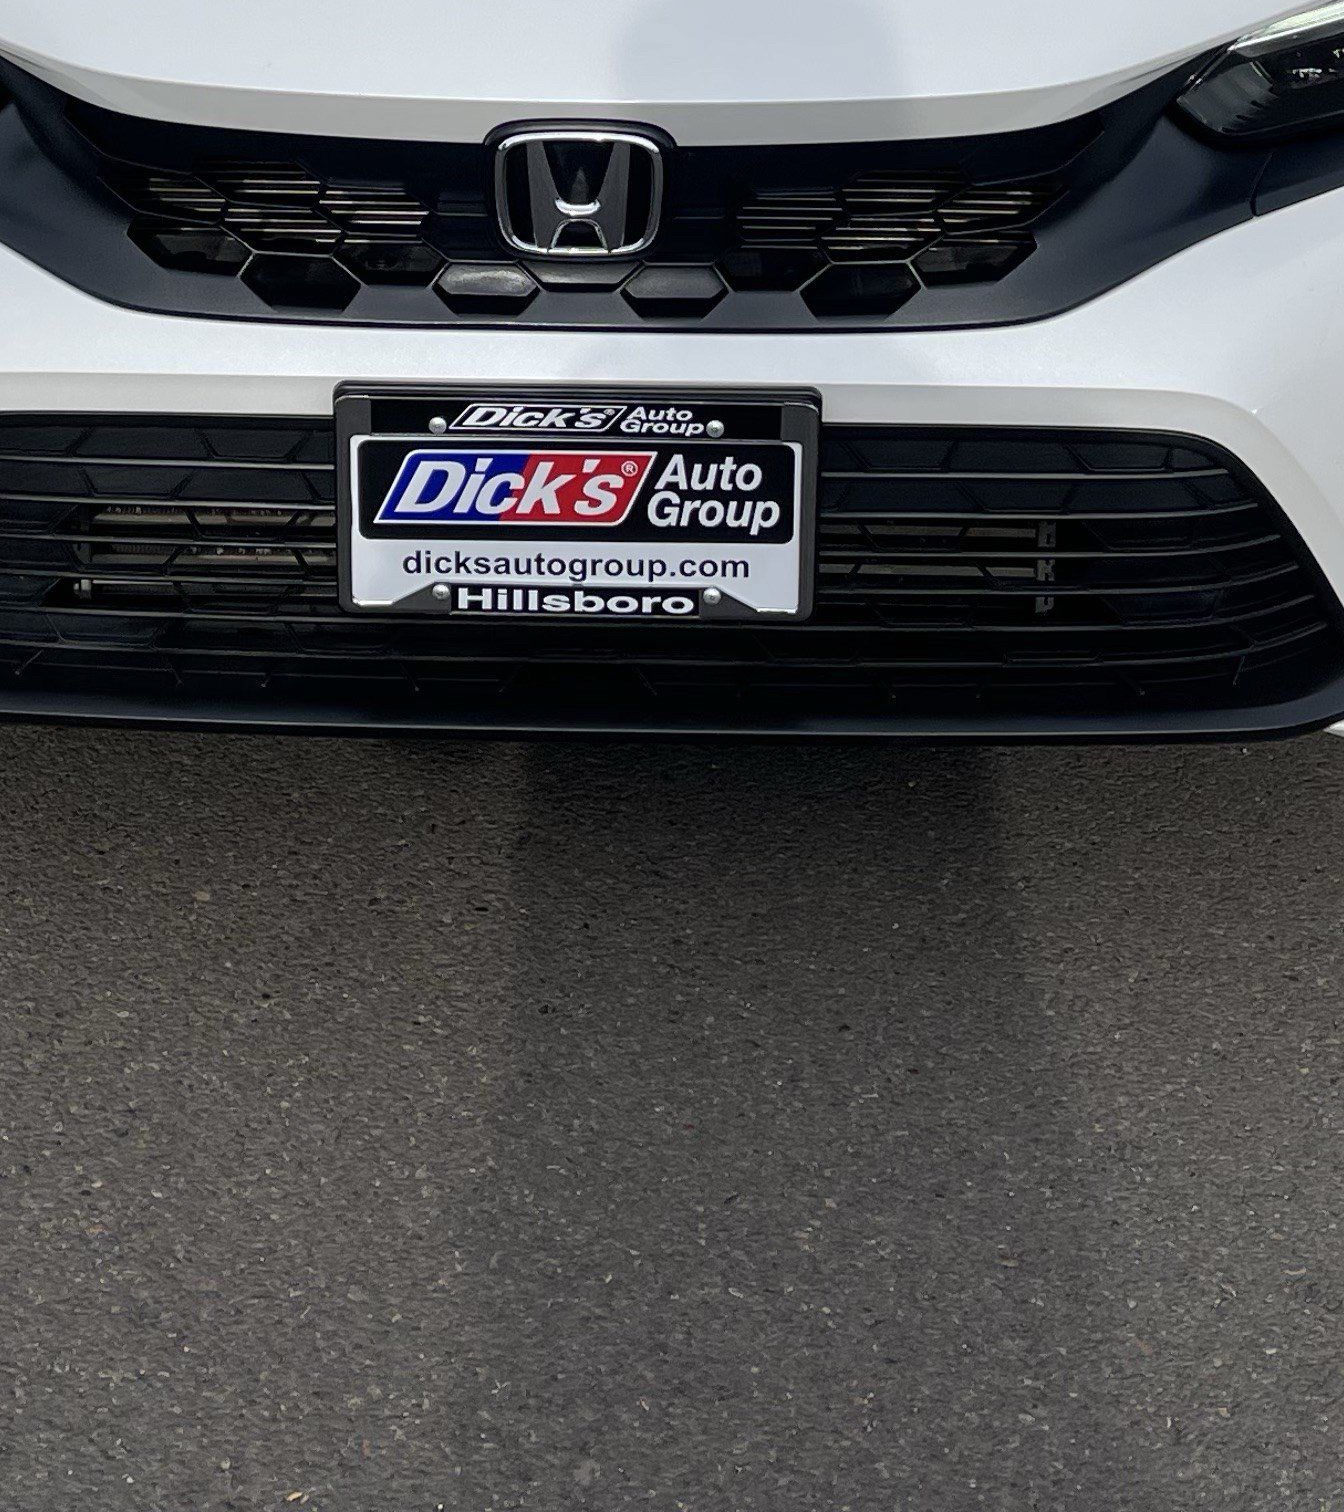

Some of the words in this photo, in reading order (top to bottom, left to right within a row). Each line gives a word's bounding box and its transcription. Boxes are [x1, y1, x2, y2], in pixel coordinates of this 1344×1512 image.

[619, 419, 704, 437] Group
[625, 406, 693, 421] Auto
[654, 454, 763, 492] Auto
[646, 491, 781, 536] Group
[402, 550, 750, 582] dicksautogroup.com
[457, 587, 695, 615] Hillsboro
